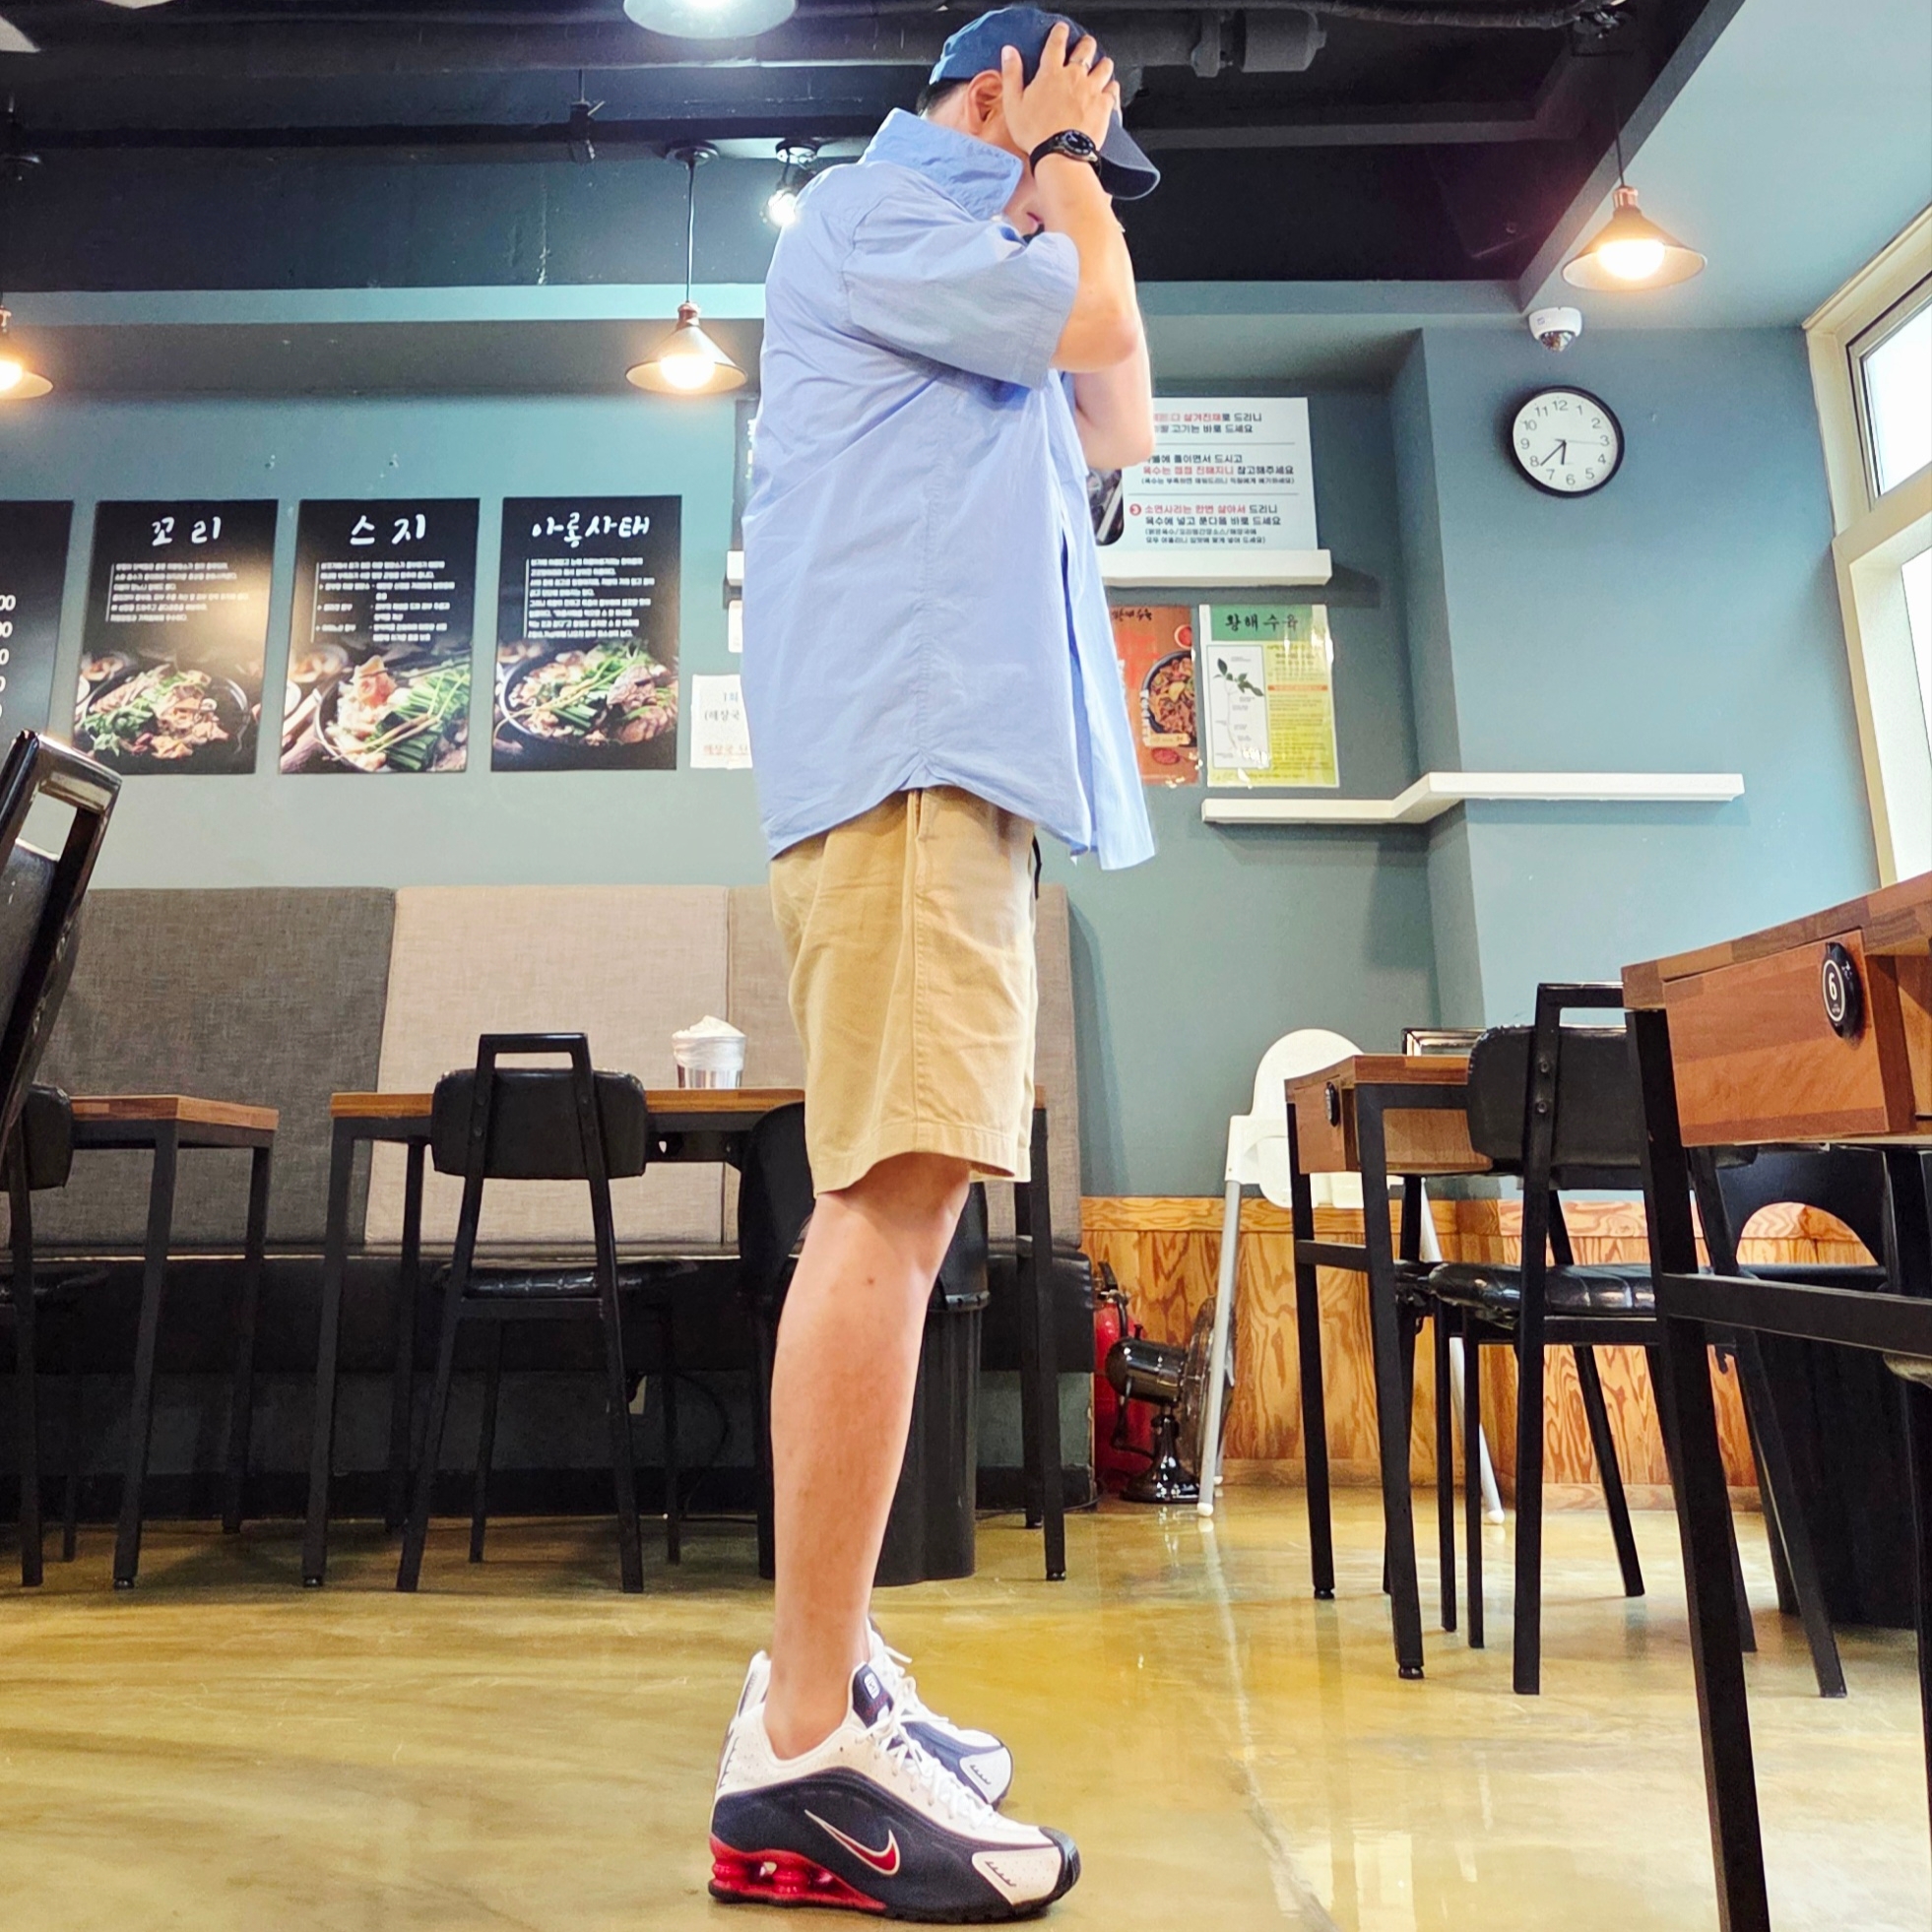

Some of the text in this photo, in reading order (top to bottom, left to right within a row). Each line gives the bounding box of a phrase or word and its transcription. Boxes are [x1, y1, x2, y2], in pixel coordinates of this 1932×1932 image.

[1552, 400, 1569, 411] 12
[1577, 405, 1582, 416] 1
[1234, 413, 1262, 422] 드리니
[1535, 406, 1548, 418] 11
[1172, 424, 1199, 433] 고기는
[1203, 424, 1221, 433] 바로
[1225, 424, 1253, 433] 드세요
[1523, 419, 1537, 431] 10
[1591, 418, 1601, 428] 2
[1520, 438, 1530, 449] 9
[1599, 434, 1610, 446] 3
[1148, 454, 1170, 463] 불에
[1214, 454, 1242, 463] 드시고
[1529, 455, 1540, 467] 8
[1597, 454, 1606, 464] 4
[1143, 466, 1171, 475] 육수는
[1196, 466, 1234, 475] 진해지니
[1238, 465, 1294, 475] 참고해주세요
[1546, 469, 1555, 481] 7
[1585, 468, 1595, 480] 5
[1566, 474, 1576, 485] 6
[1145, 504, 1191, 514] 소면사리는
[1195, 504, 1214, 514] 한번
[1250, 504, 1277, 514] 드리니
[1146, 516, 1173, 526] 육수에
[1177, 516, 1195, 525] 넣고
[1231, 516, 1249, 525] 바로
[1253, 516, 1281, 525] 드세요
[152, 516, 222, 547] 꼬리
[350, 513, 426, 546] 스지
[532, 511, 650, 548] 아롱사태
[1829, 972, 1837, 1000] 6
